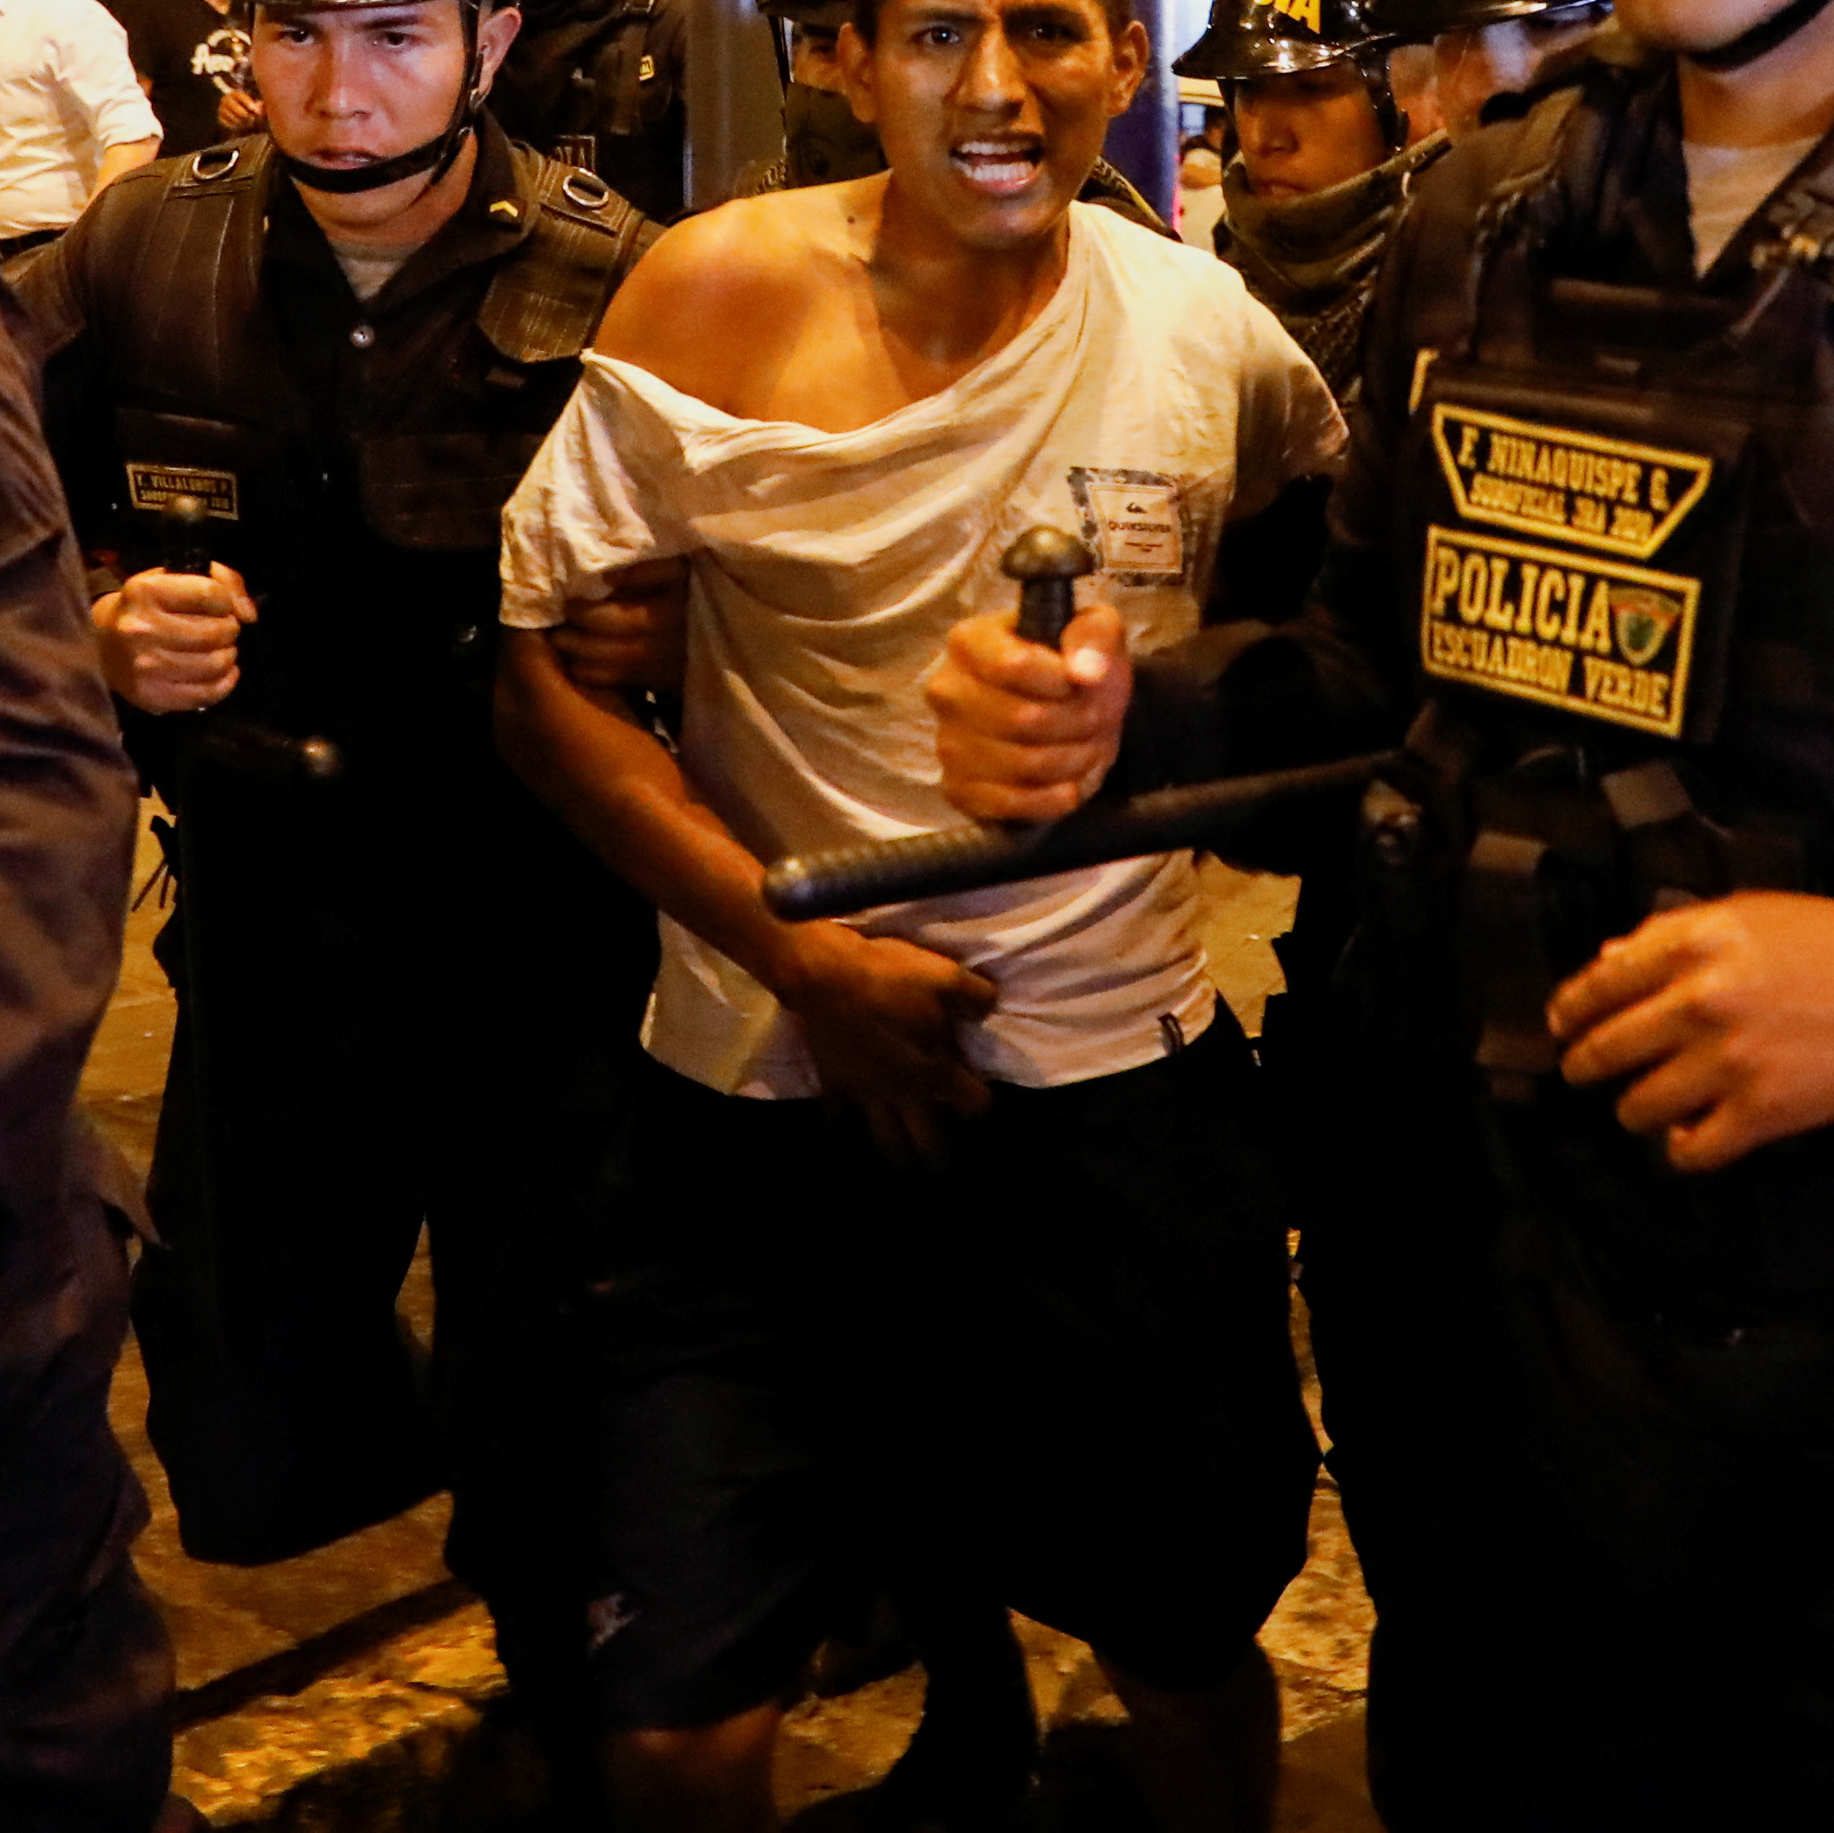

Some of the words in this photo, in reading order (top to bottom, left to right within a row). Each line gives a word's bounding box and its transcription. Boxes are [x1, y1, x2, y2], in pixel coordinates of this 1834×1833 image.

[1431, 545, 1612, 655] POLICIA
[1431, 619, 1574, 695] ESCUADRON
[1583, 654, 1670, 718] VERDE
